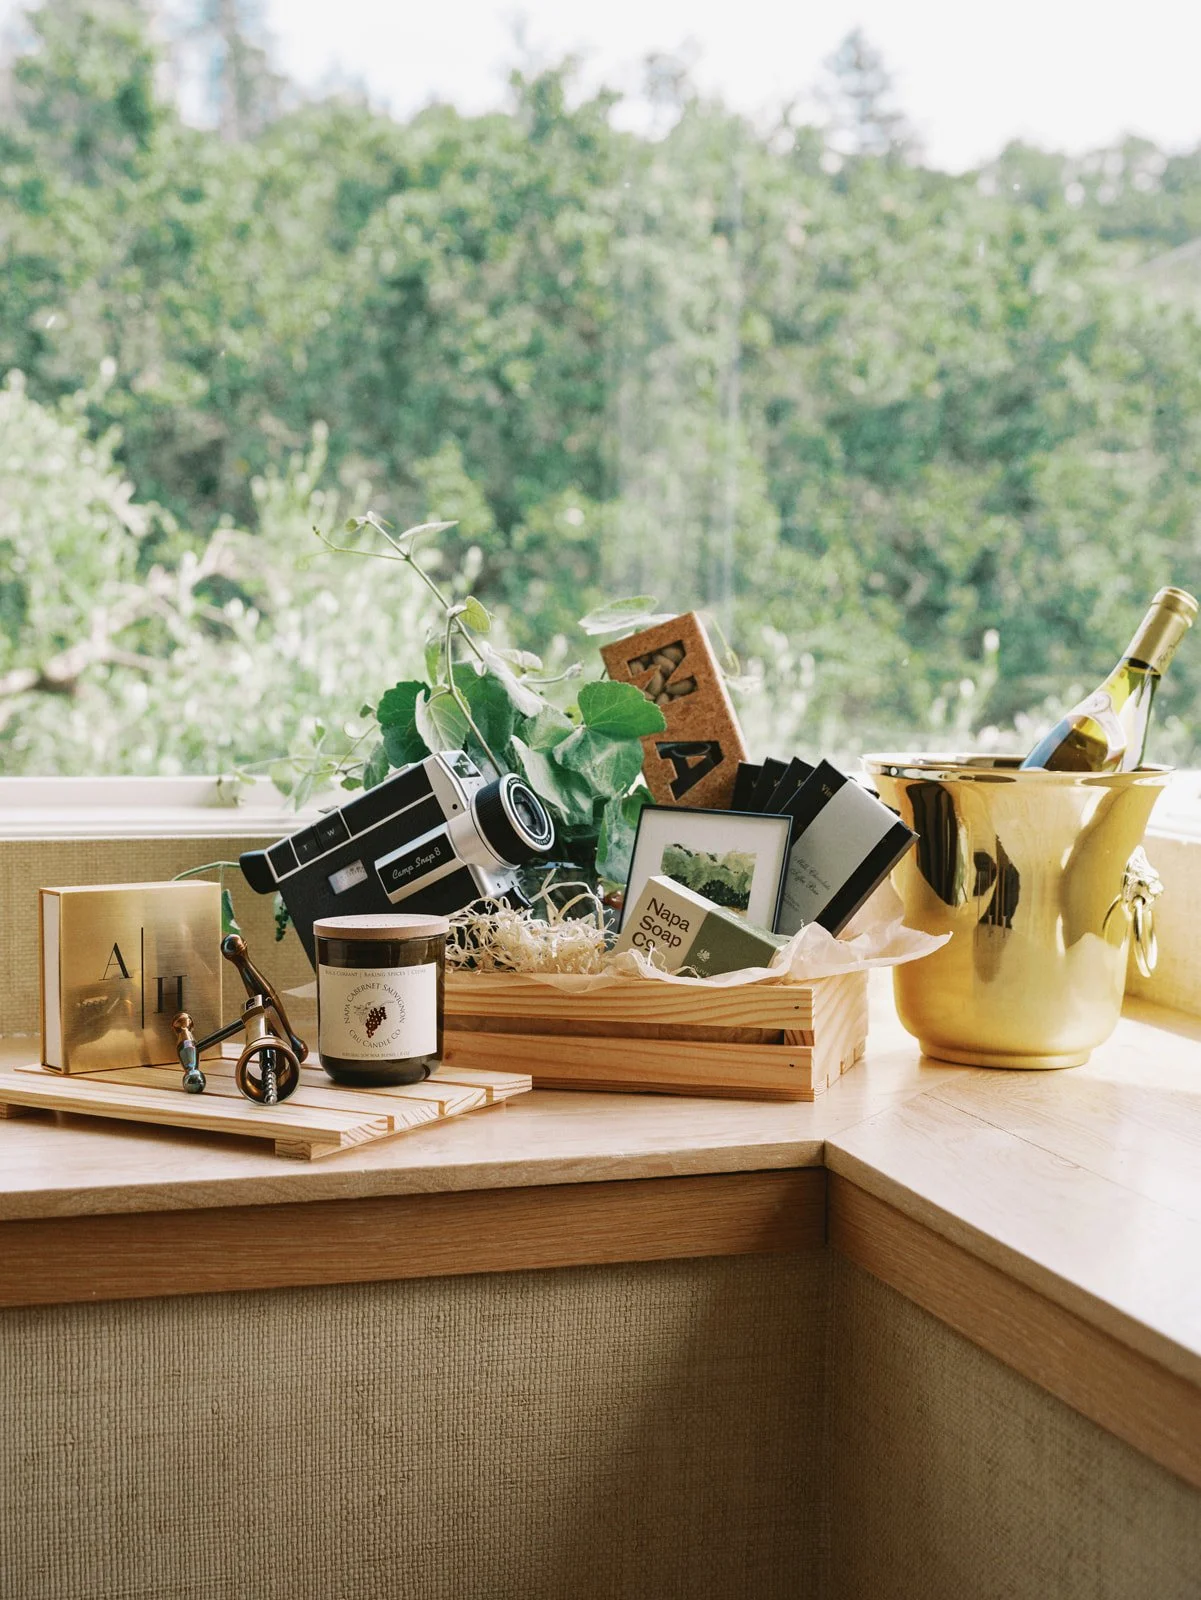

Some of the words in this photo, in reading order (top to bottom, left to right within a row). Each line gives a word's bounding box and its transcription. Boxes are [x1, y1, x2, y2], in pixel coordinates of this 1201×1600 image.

[392, 865, 415, 879] Camp
[415, 852, 436, 868] Snap
[434, 846, 441, 856] 8
[639, 915, 683, 949] Soap
[646, 897, 691, 933] Napa
[99, 942, 134, 981] A
[346, 982, 380, 1002] CABERNET
[383, 983, 407, 1024] SAUVIGNON
[349, 1029, 361, 1044] CRU
[362, 1038, 392, 1049] CANDLE
[391, 1028, 402, 1040] CO
